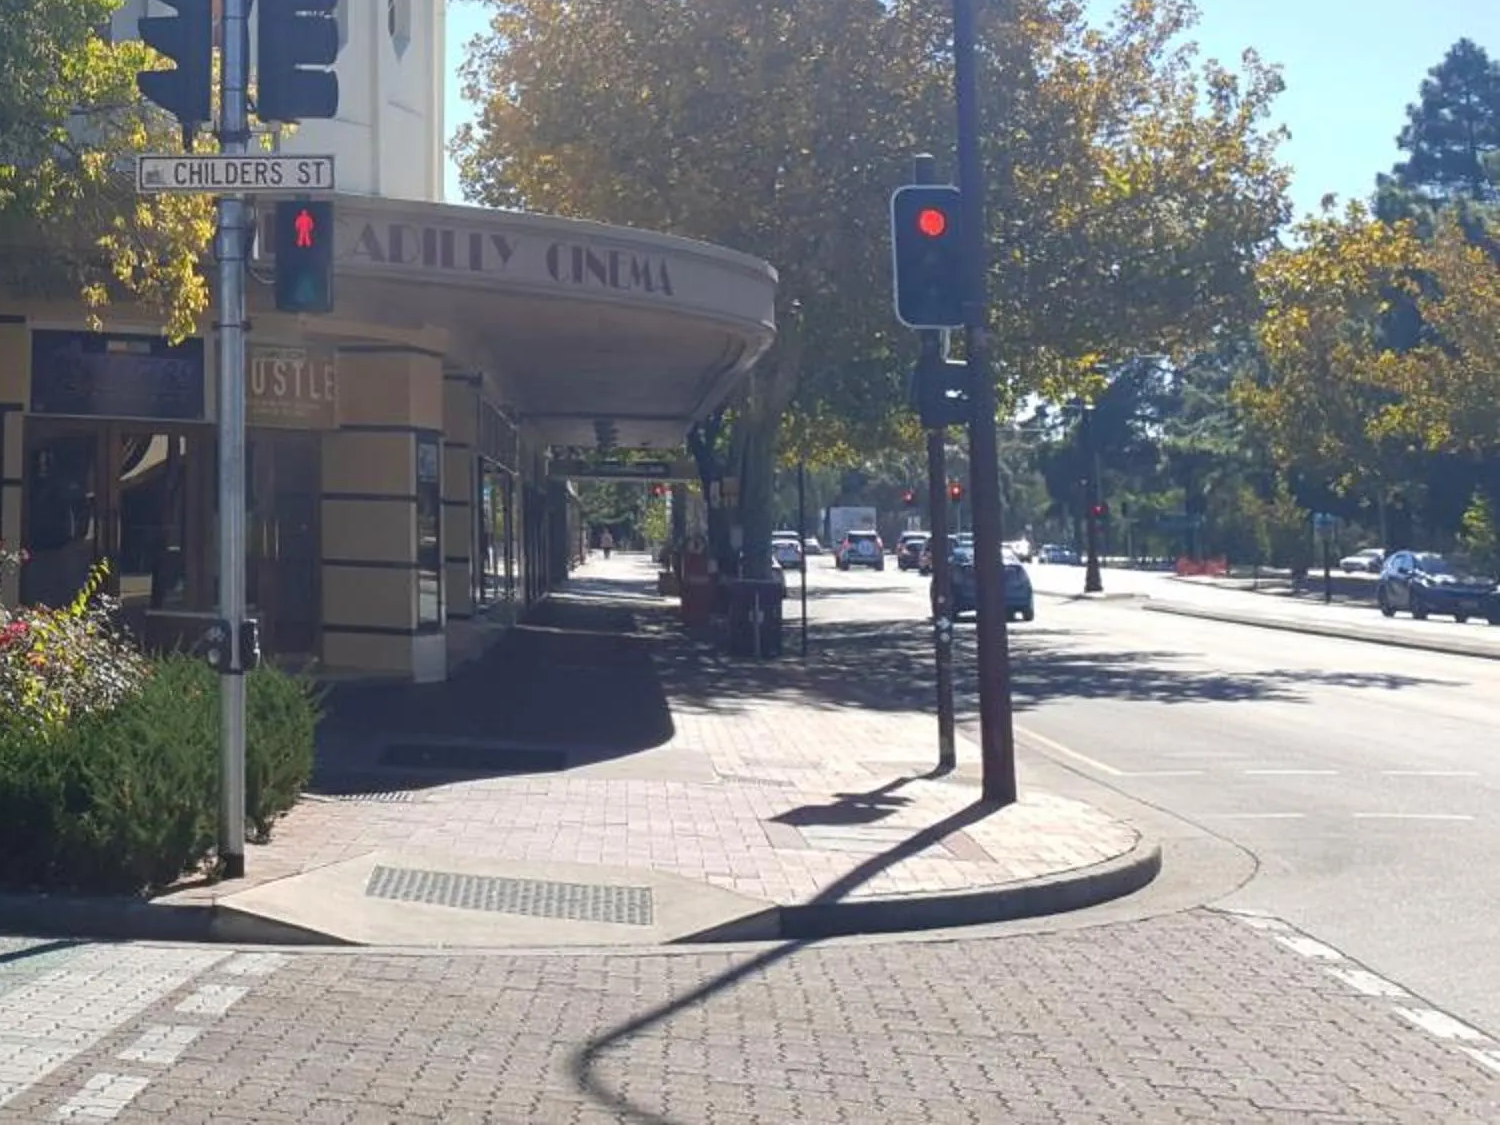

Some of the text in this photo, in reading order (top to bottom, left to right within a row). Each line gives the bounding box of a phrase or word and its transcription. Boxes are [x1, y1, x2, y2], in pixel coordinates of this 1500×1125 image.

[174, 161, 325, 185] CHILDERS ST
[335, 215, 675, 296] ADILLY CINEMA
[251, 358, 334, 401] USTLE
